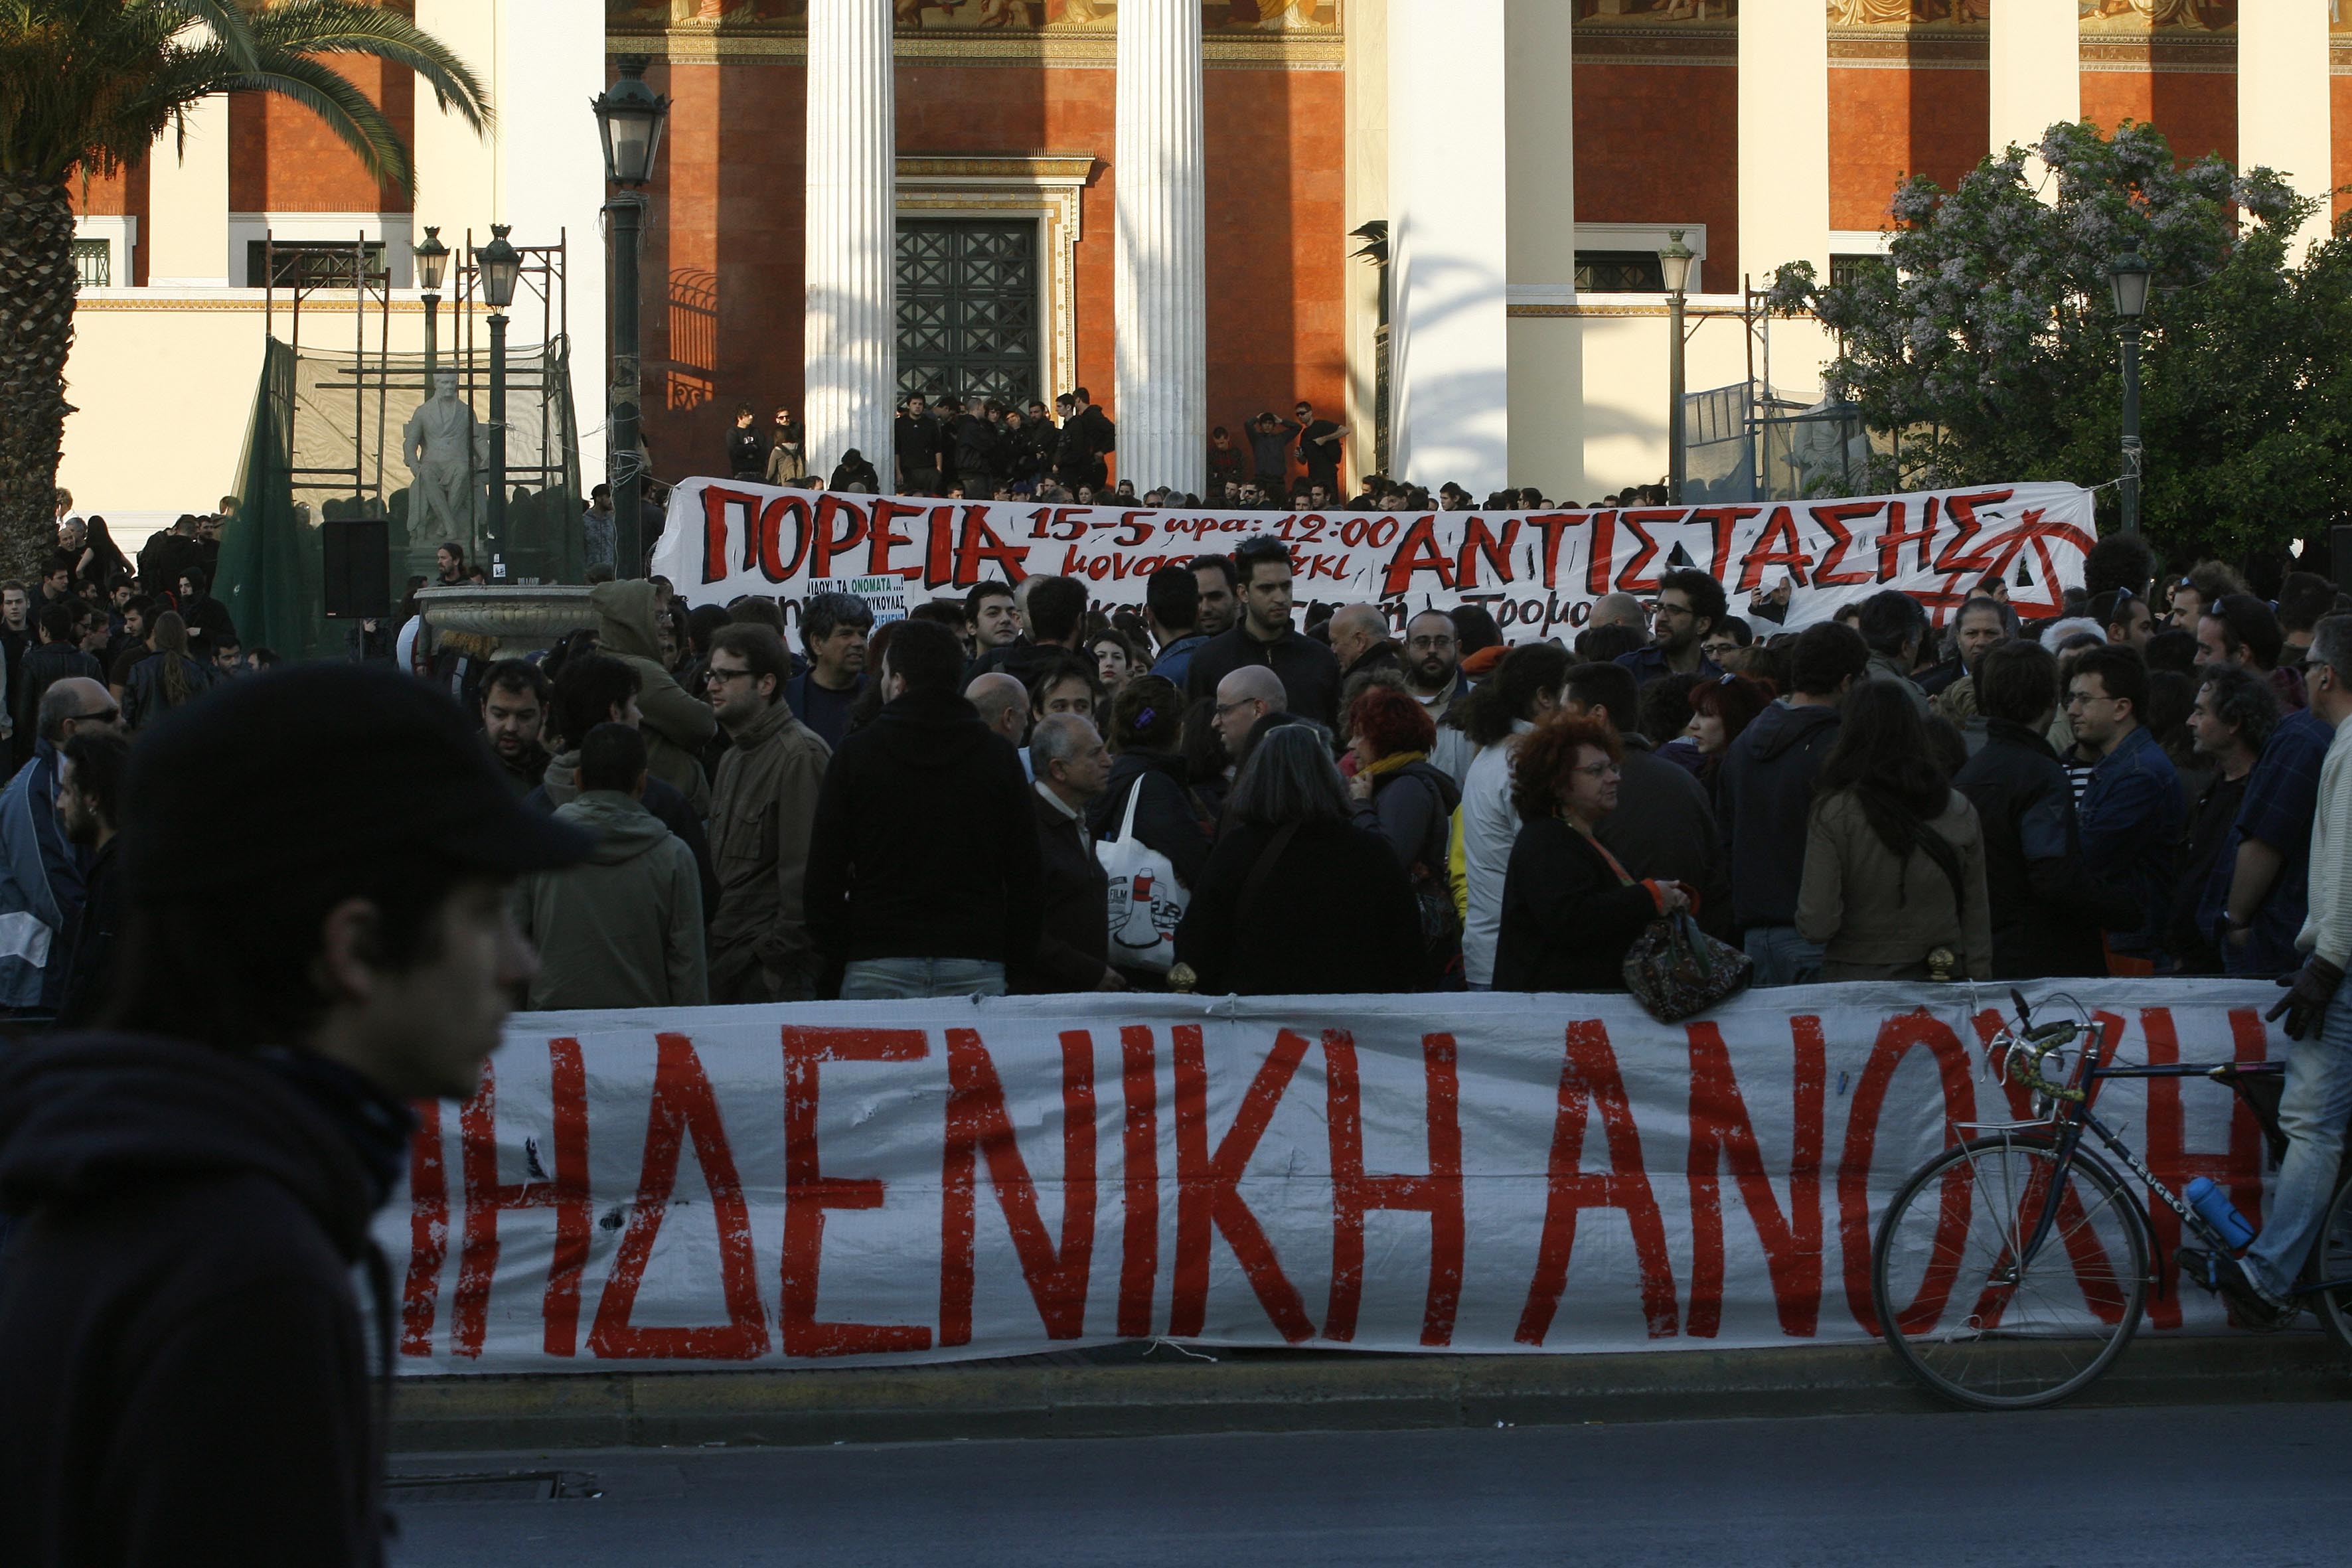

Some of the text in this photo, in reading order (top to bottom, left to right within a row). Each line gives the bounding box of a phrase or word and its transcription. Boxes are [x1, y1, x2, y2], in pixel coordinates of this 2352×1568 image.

[702, 485, 1033, 590] ΠΟΡΕΙΑ
[1028, 507, 1157, 546] 15-5
[1273, 514, 1399, 548] 12:00
[1379, 489, 2014, 602] ΑΝΤΙΣΤΑΣΗΣ
[837, 580, 848, 593] ΤΑ
[863, 595, 904, 611] ΟΥΚΟΥΛΑΣ
[400, 1005, 2267, 1360] ΗΔΕΝΙΚΗ ΑΝΟΧΗ
[2126, 1155, 2195, 1222] PEUGEOT
